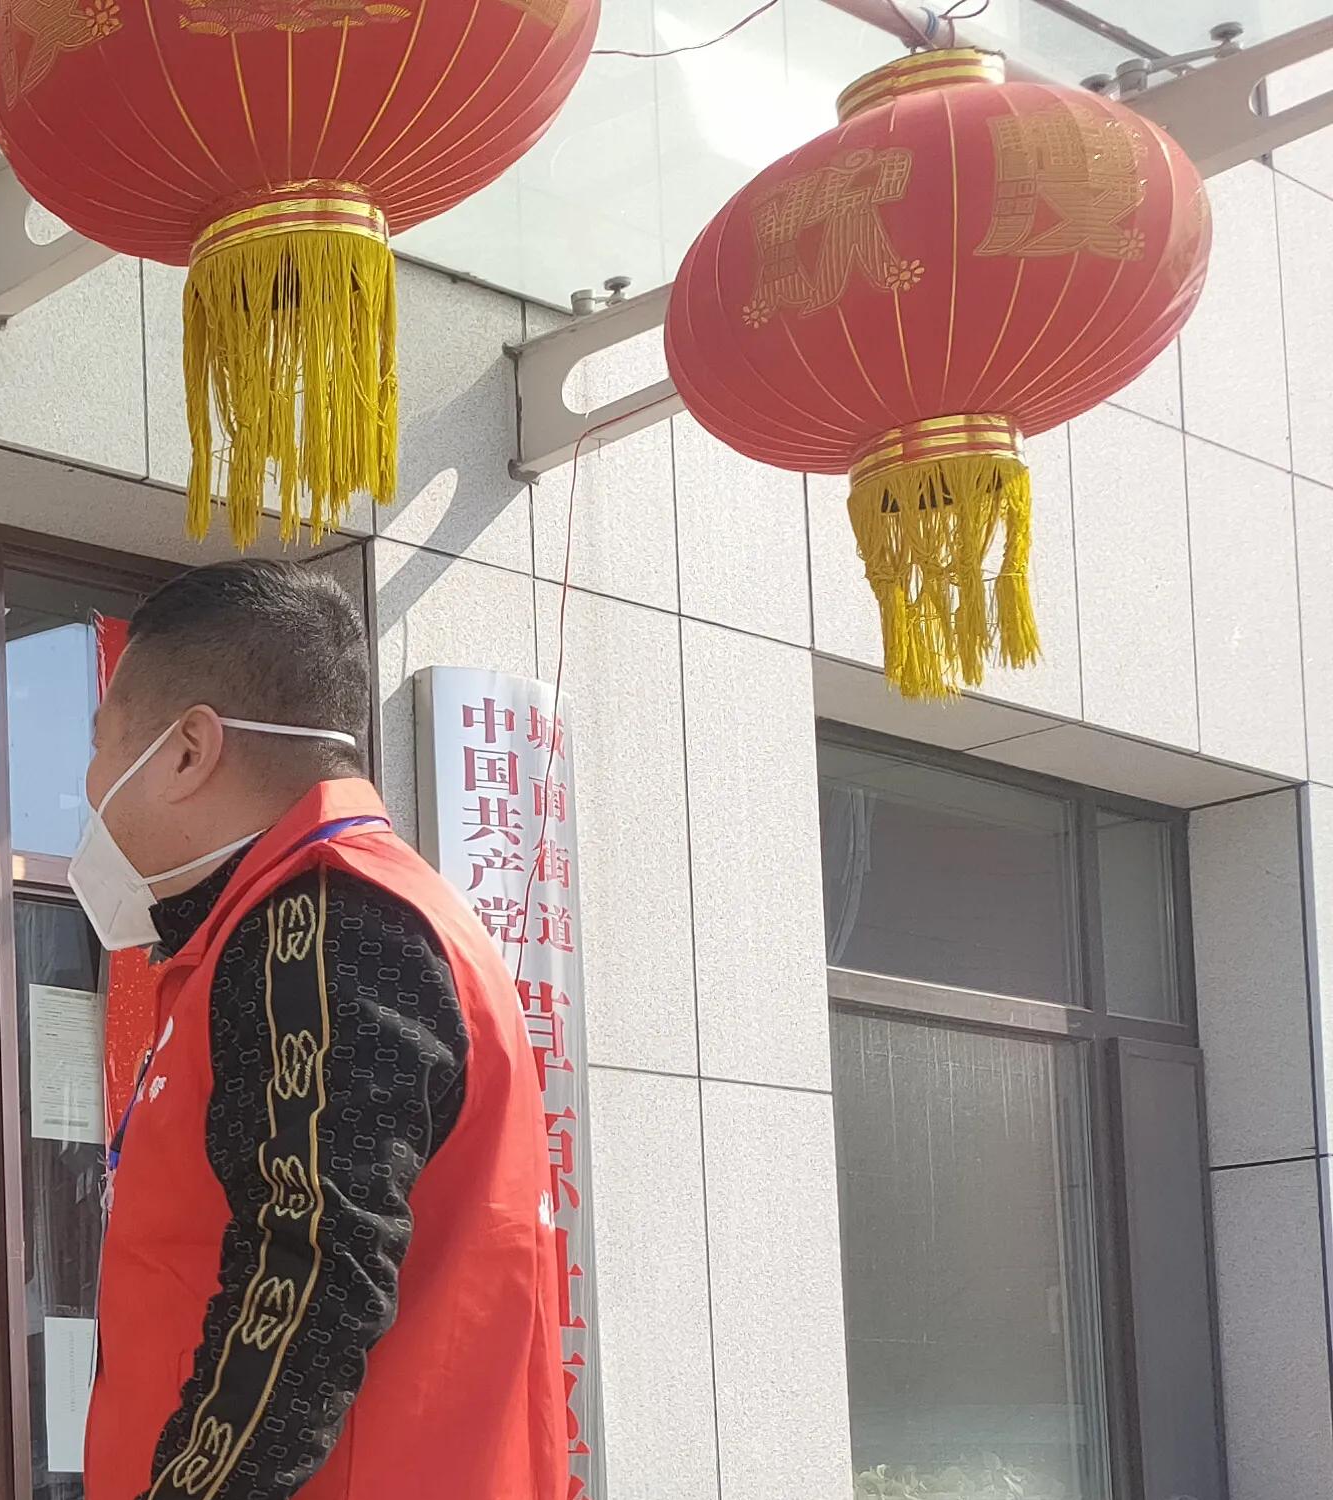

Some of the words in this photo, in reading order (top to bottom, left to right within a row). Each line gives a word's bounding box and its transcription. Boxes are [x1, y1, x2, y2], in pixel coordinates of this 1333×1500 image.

[461, 697, 529, 945] 中国共产党
